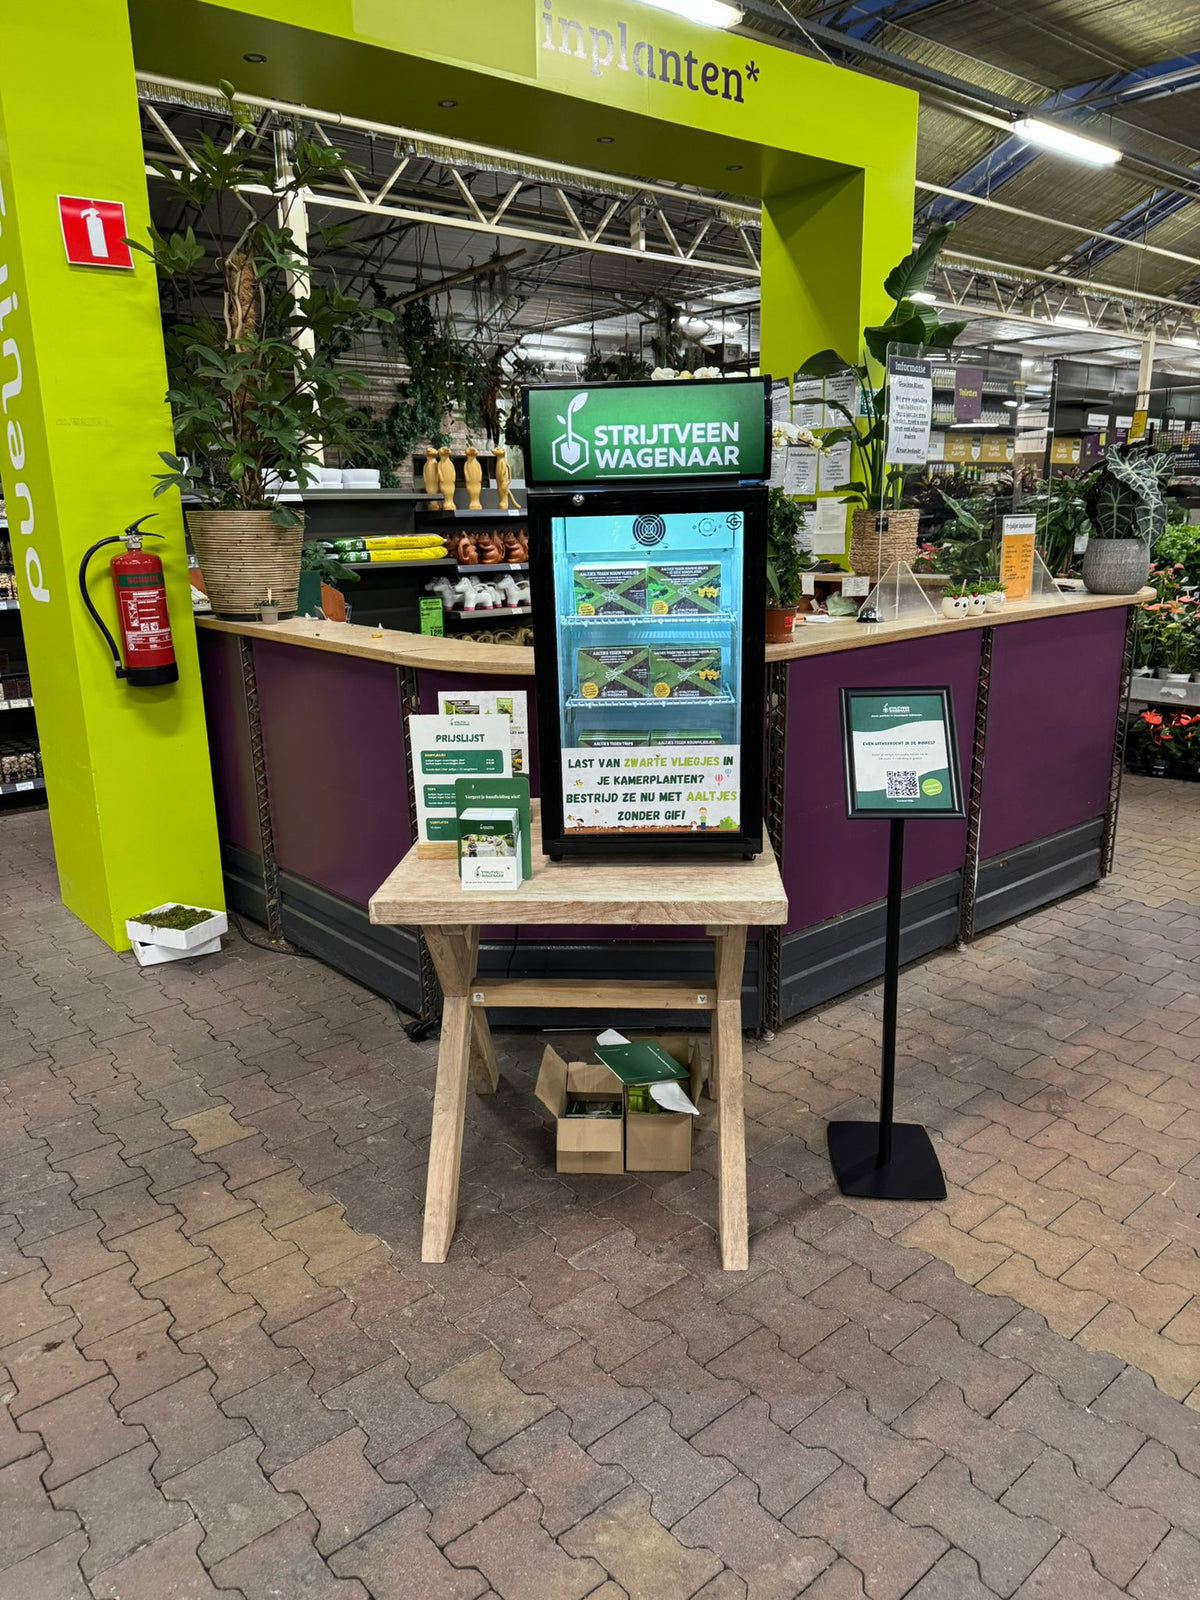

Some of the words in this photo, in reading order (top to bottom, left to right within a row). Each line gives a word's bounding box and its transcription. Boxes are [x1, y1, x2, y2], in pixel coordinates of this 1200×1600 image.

[895, 362, 926, 373] Informatie
[594, 422, 739, 446] STRIJTVEEN
[595, 446, 740, 468] WAGENAAR
[436, 734, 485, 743] PRIJSLIJST
[568, 758, 596, 768] LAST
[598, 758, 620, 768] VAN
[624, 757, 667, 767] ZWARTE
[671, 756, 720, 767] VLIEGJES
[723, 756, 733, 766] IN
[597, 776, 610, 786] JE
[613, 774, 705, 785] KAMERPLANTEN?
[566, 793, 618, 803] BESTRIJD
[622, 793, 636, 803] ZE
[641, 793, 655, 802] NU
[659, 792, 682, 802] MET
[687, 791, 737, 801] AALTJES
[617, 810, 660, 821] ZONDER
[664, 810, 686, 820] GIF!
